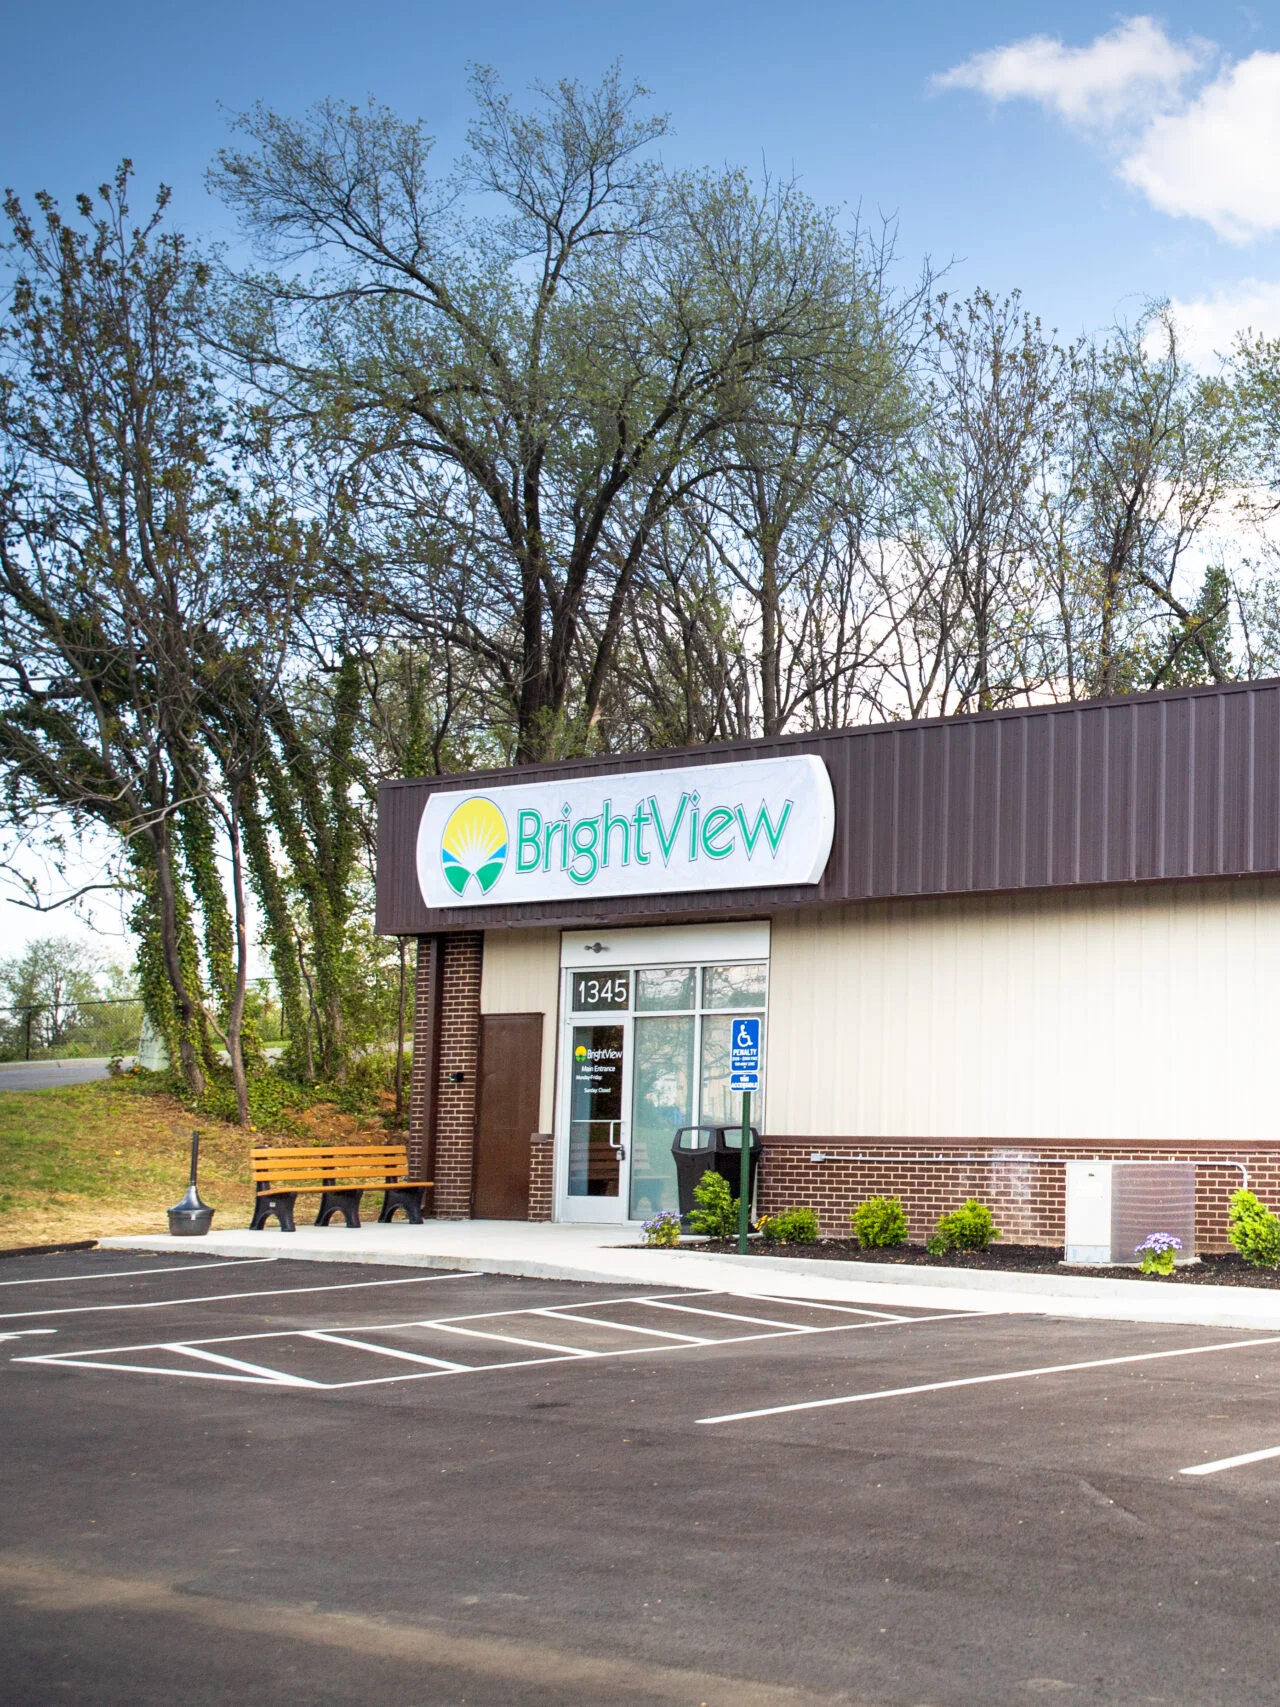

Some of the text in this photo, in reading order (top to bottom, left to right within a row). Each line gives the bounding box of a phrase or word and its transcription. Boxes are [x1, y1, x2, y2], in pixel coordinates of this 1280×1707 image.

[516, 789, 794, 886] BrightView
[579, 979, 627, 1003] 1345
[587, 1048, 623, 1061] BrightView
